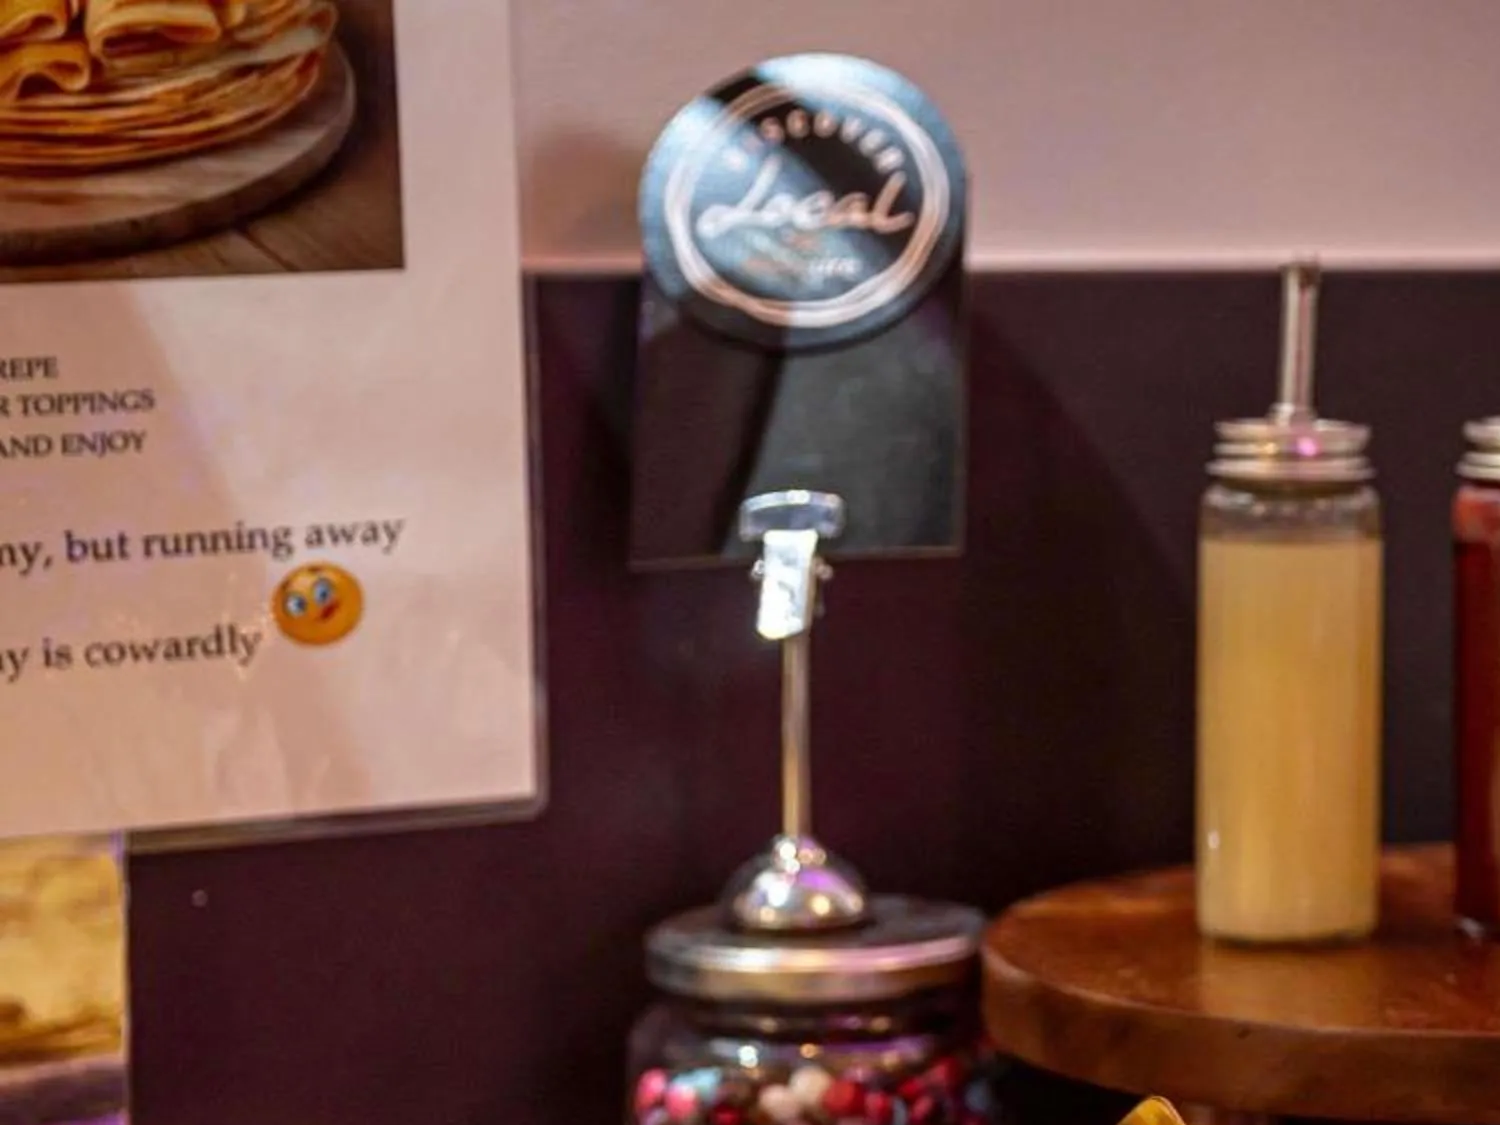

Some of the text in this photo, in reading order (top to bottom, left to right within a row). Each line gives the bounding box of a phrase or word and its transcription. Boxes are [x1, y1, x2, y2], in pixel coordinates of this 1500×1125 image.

[16, 388, 155, 418] TOPPINGS
[60, 430, 147, 458] ENJOY
[64, 529, 130, 562] but
[142, 520, 294, 562] running
[304, 517, 406, 555] away
[42, 636, 73, 670] is
[84, 622, 263, 667] cowardly
